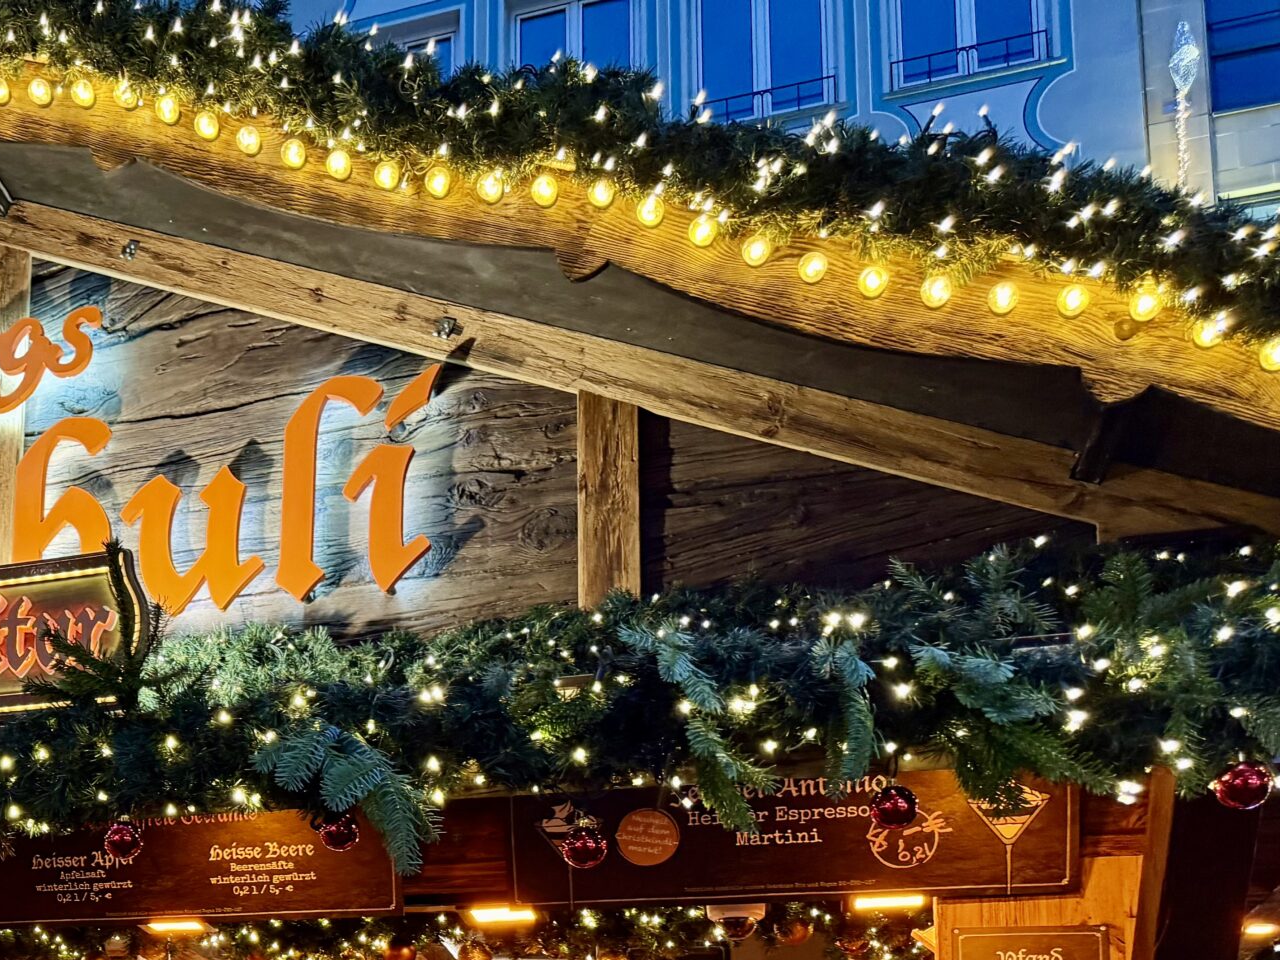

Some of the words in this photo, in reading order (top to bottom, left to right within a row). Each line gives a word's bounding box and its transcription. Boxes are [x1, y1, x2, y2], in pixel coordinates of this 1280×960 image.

[775, 804, 870, 823] Espresso
[735, 828, 823, 846] Martini
[209, 842, 262, 861] Heisse
[264, 842, 315, 859] Beere
[32, 851, 88, 870] Heisser
[230, 861, 295, 872] Beerensäfte
[60, 870, 107, 882] Apfelsaft
[210, 874, 270, 885] winterlich
[272, 871, 317, 884] gewürzt
[36, 882, 91, 892] winterlich
[93, 880, 134, 892] gewürzt
